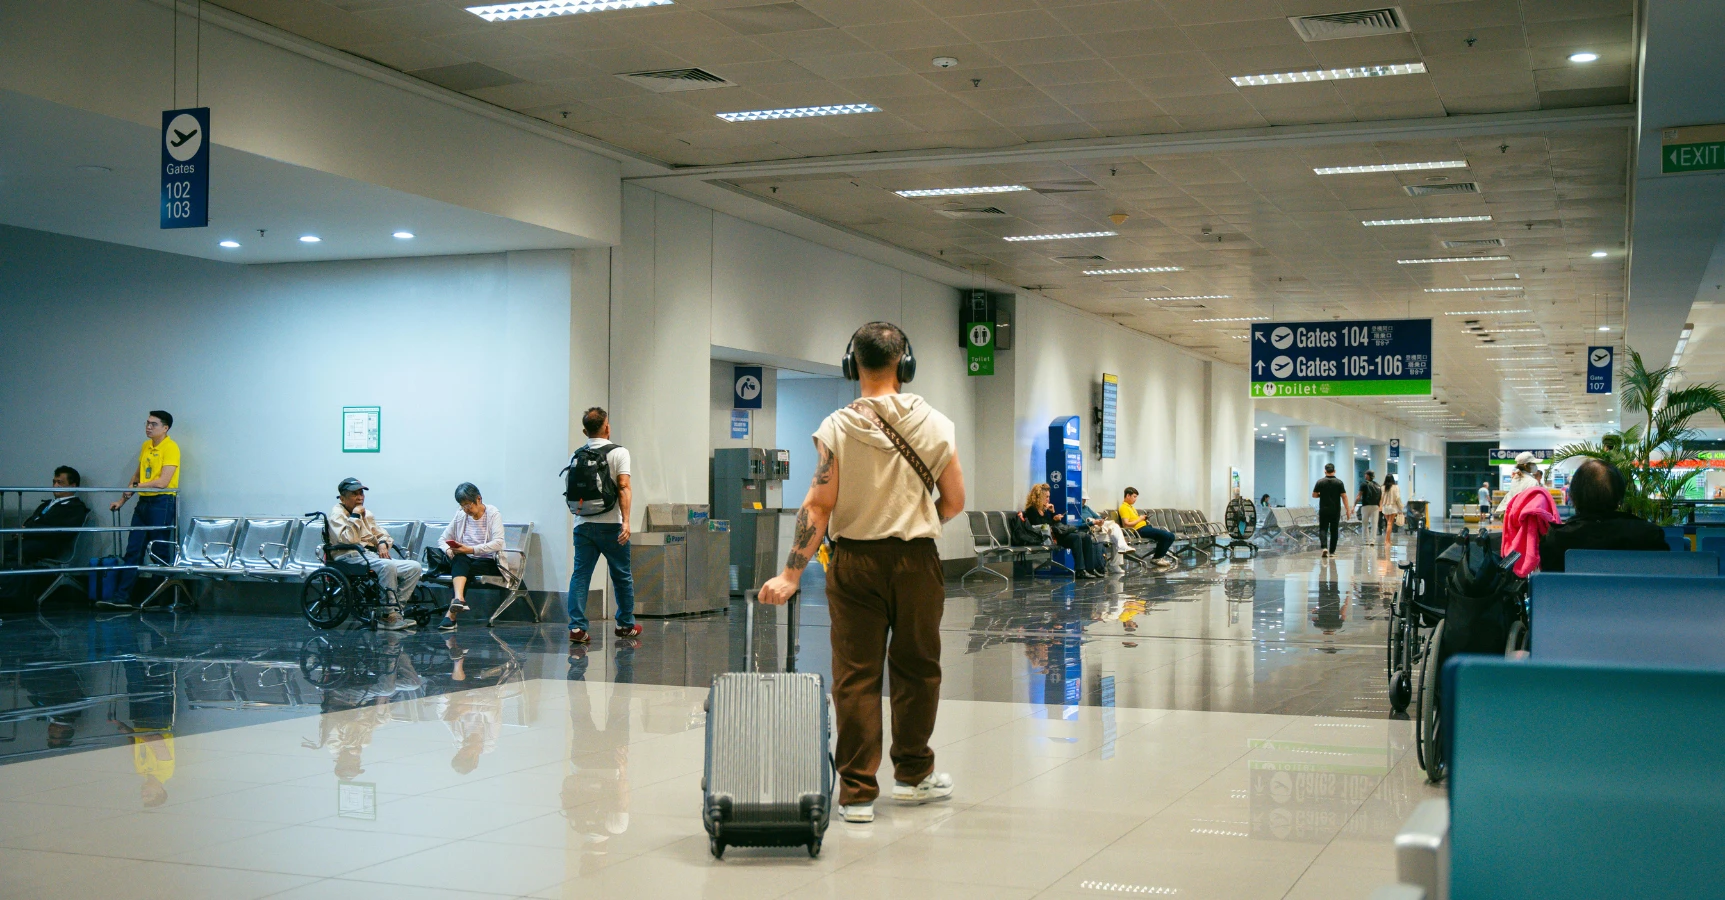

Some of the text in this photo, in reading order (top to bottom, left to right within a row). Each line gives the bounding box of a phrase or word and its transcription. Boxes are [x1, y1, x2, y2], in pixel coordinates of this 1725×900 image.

[1681, 145, 1720, 166] EXIT
[166, 163, 195, 175] Gates
[166, 181, 190, 199] 102
[166, 201, 190, 219] 103
[1296, 326, 1369, 348] Gates 104
[1296, 355, 1403, 377] Gates 105-106
[1278, 384, 1317, 395] Toilet
[1590, 382, 1605, 391] 107
